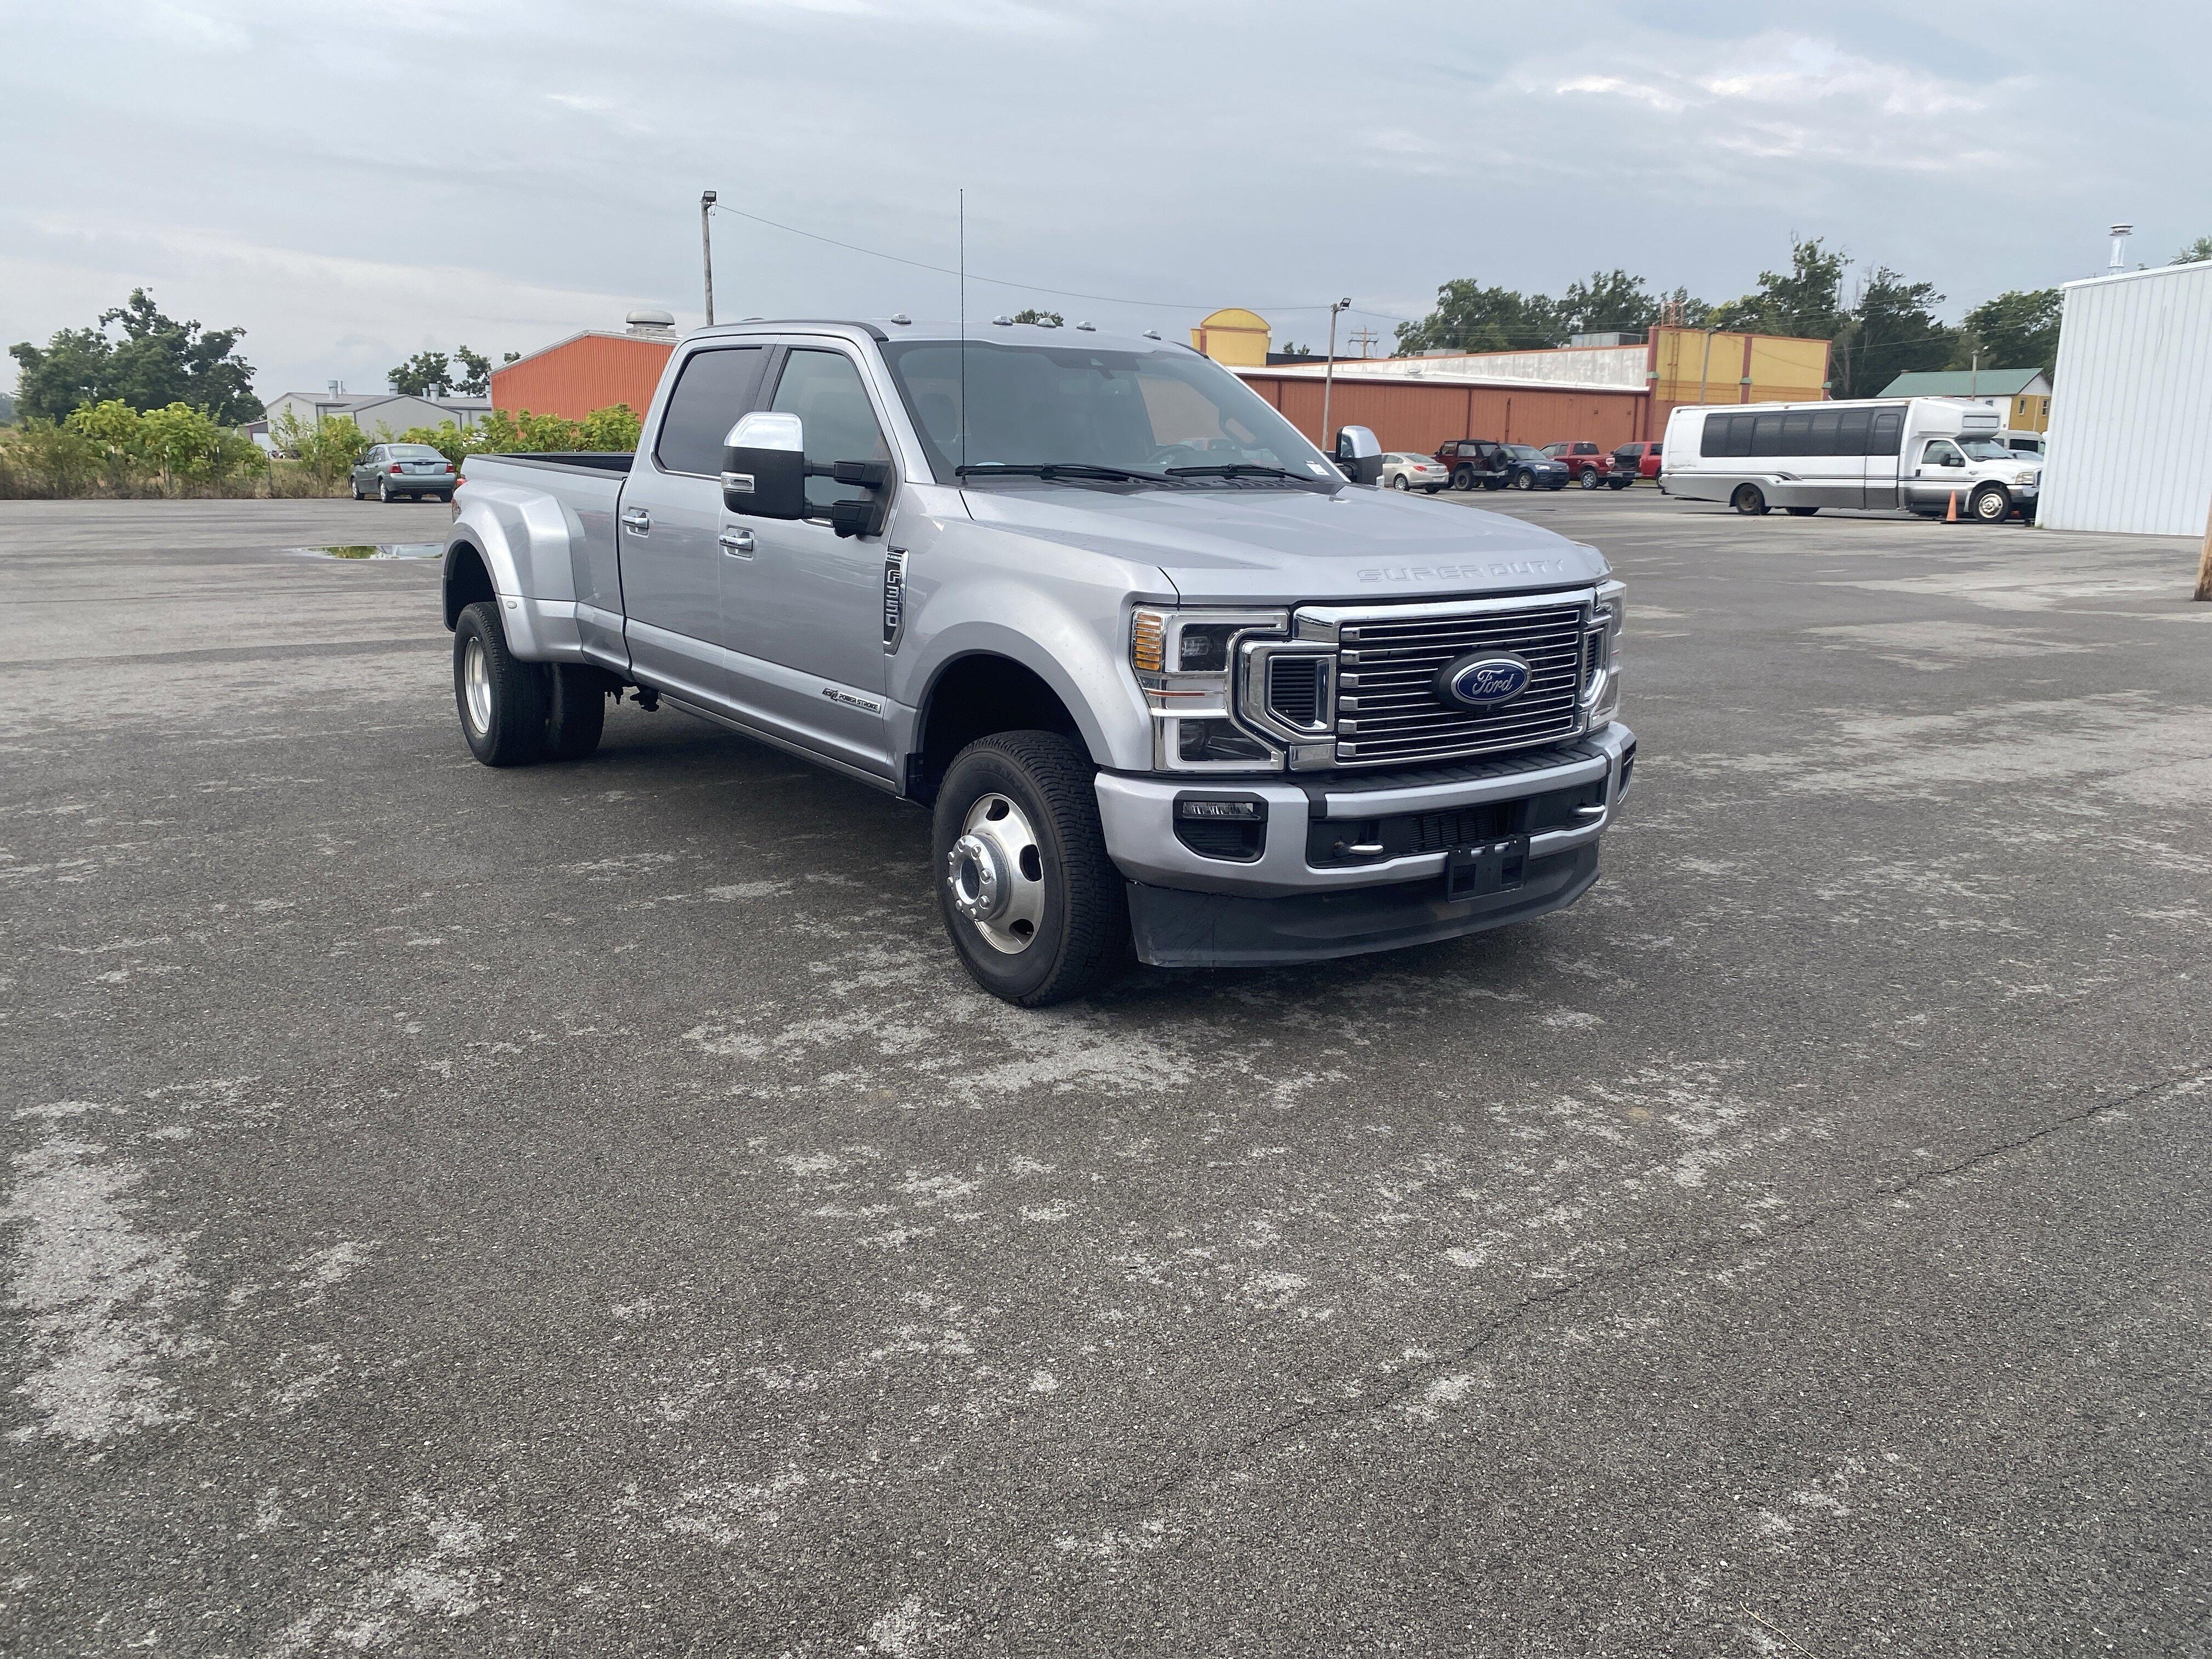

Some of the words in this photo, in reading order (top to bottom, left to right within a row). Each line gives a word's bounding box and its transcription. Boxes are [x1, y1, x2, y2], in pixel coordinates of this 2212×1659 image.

[1357, 565, 1484, 583] SUPER
[1488, 559, 1565, 577] DUTY
[1472, 669, 1513, 695] Ford
[839, 693, 856, 704] POWER
[857, 699, 878, 710] STROKE
